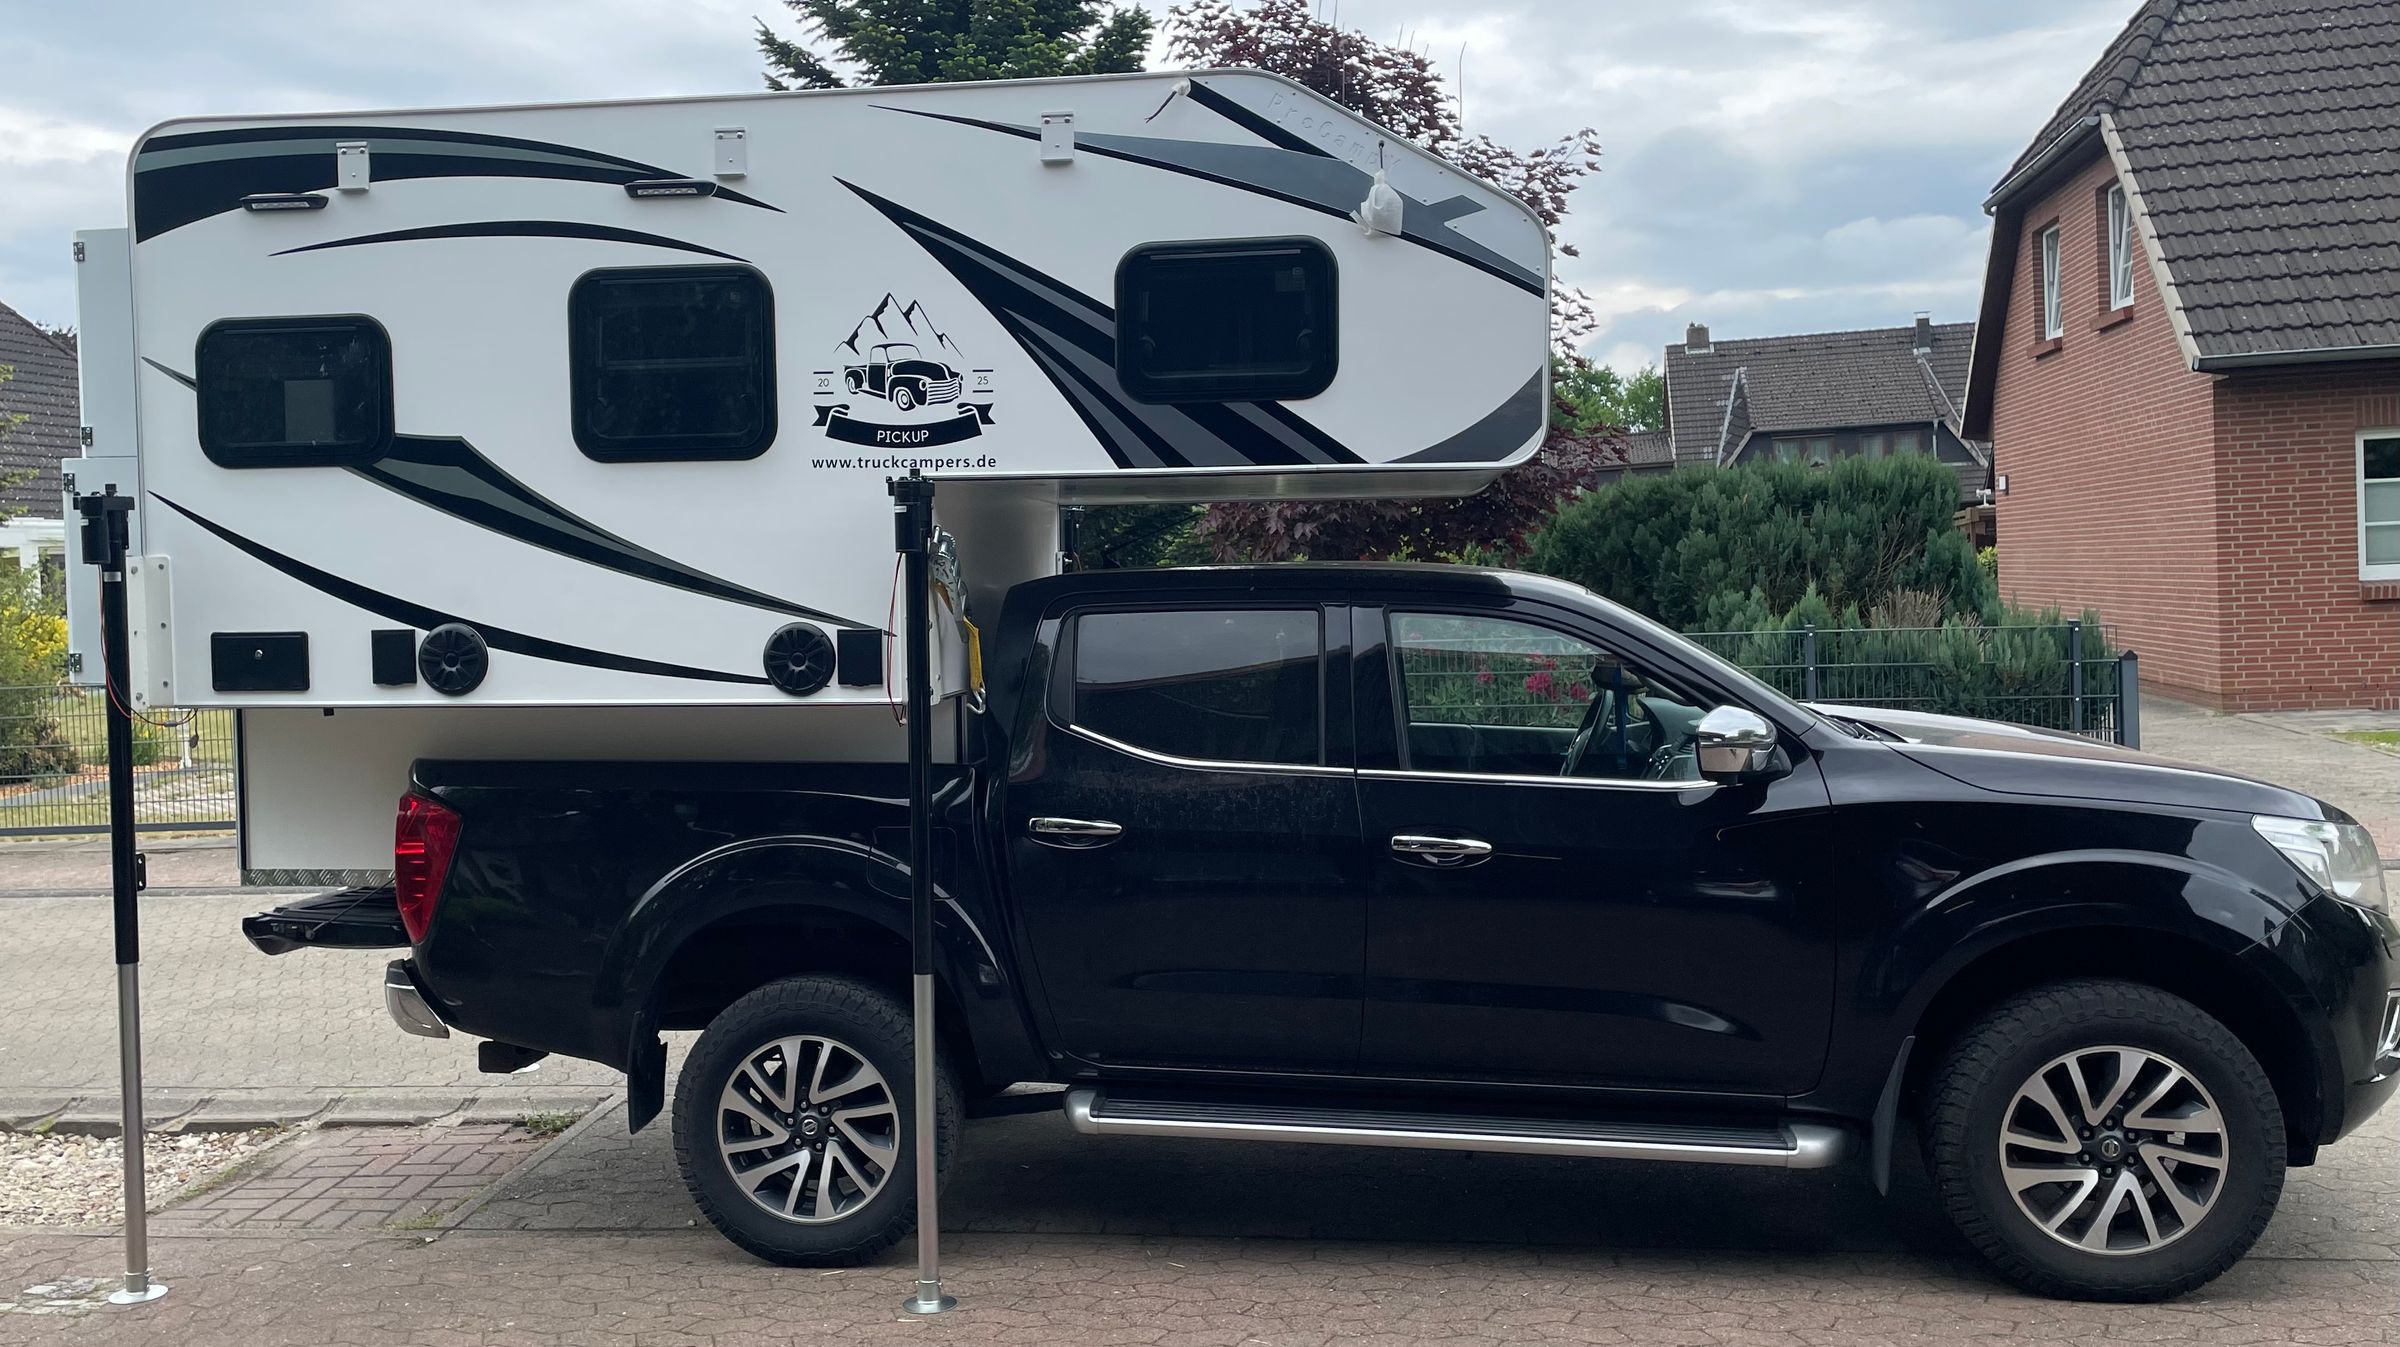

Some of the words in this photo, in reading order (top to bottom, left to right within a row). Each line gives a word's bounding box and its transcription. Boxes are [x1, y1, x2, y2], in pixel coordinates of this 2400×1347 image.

[817, 378, 830, 388] 20
[977, 376, 989, 386] 25
[876, 430, 930, 444] PICKUP
[811, 454, 997, 471] www.truckcampers.de
